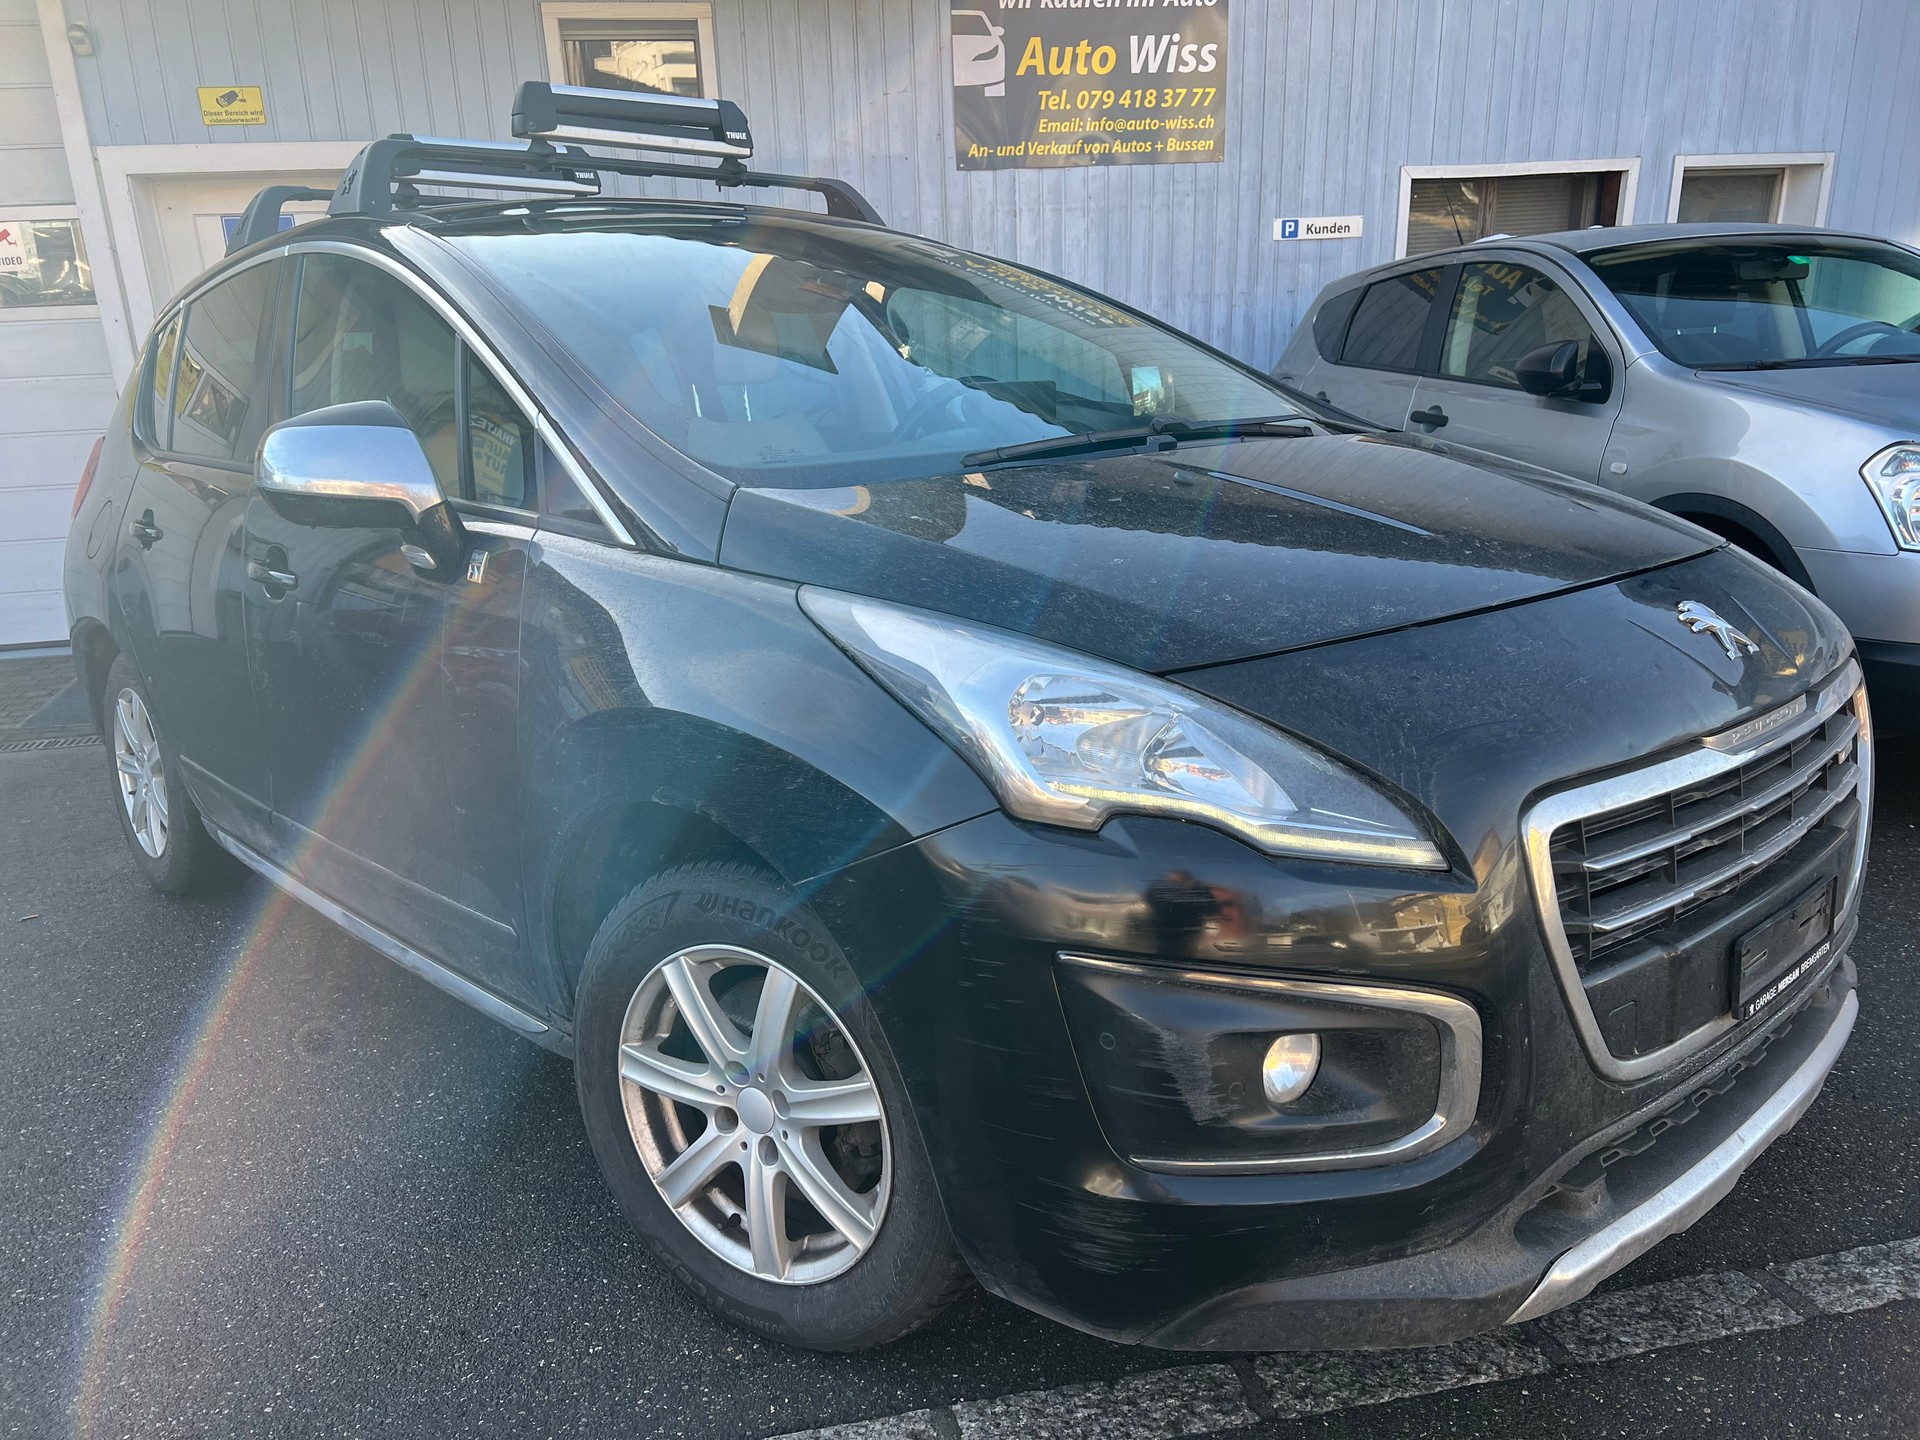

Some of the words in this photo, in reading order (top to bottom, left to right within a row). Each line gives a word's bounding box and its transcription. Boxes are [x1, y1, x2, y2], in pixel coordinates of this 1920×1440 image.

[1016, 36, 1117, 76] Auto
[1129, 32, 1218, 74] Wiss
[1038, 89, 1071, 111] Tel.
[1076, 90, 1115, 110] 079
[1118, 89, 1157, 109] 418
[1160, 88, 1189, 108] 37
[1191, 87, 1217, 107] 77
[1038, 118, 1084, 133] Email:
[1085, 114, 1215, 134] info@auto-wiss.ch
[725, 131, 748, 141] THULE
[967, 143, 994, 158] An-
[996, 141, 1024, 156] und
[1028, 139, 1083, 156] Verkauf
[1083, 141, 1110, 155] von
[1112, 140, 1152, 154] Autos
[1166, 137, 1215, 152] Bussen
[574, 171, 595, 180] THULE
[1285, 221, 1295, 237] P
[1306, 222, 1351, 235] Kunden
[1755, 985, 1778, 1011] GARAGE
[1800, 941, 1831, 974] BREMGARTEN
